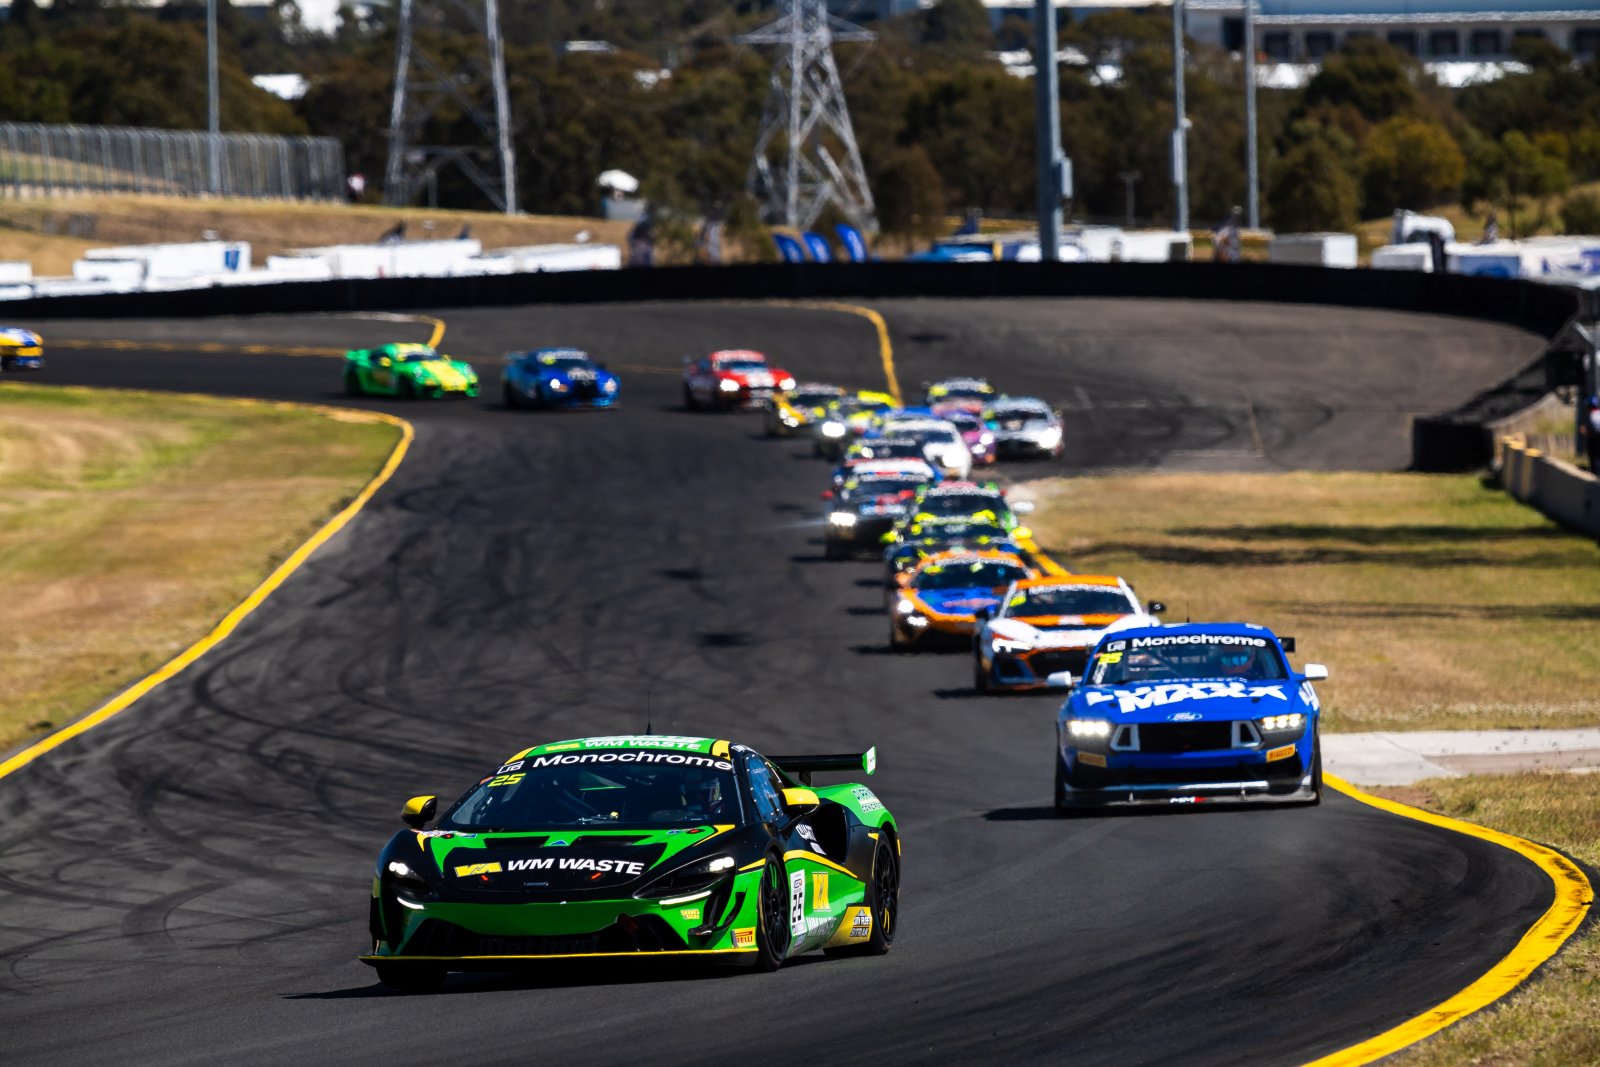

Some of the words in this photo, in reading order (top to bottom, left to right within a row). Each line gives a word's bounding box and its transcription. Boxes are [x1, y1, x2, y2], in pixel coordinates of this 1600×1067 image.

[1131, 633, 1267, 648] Monochrome
[582, 739, 622, 748] WM
[628, 739, 702, 750] WASTE
[532, 752, 734, 771] Monochrome
[487, 772, 527, 788] 25
[507, 858, 555, 871] WM
[559, 858, 645, 875] WASTE
